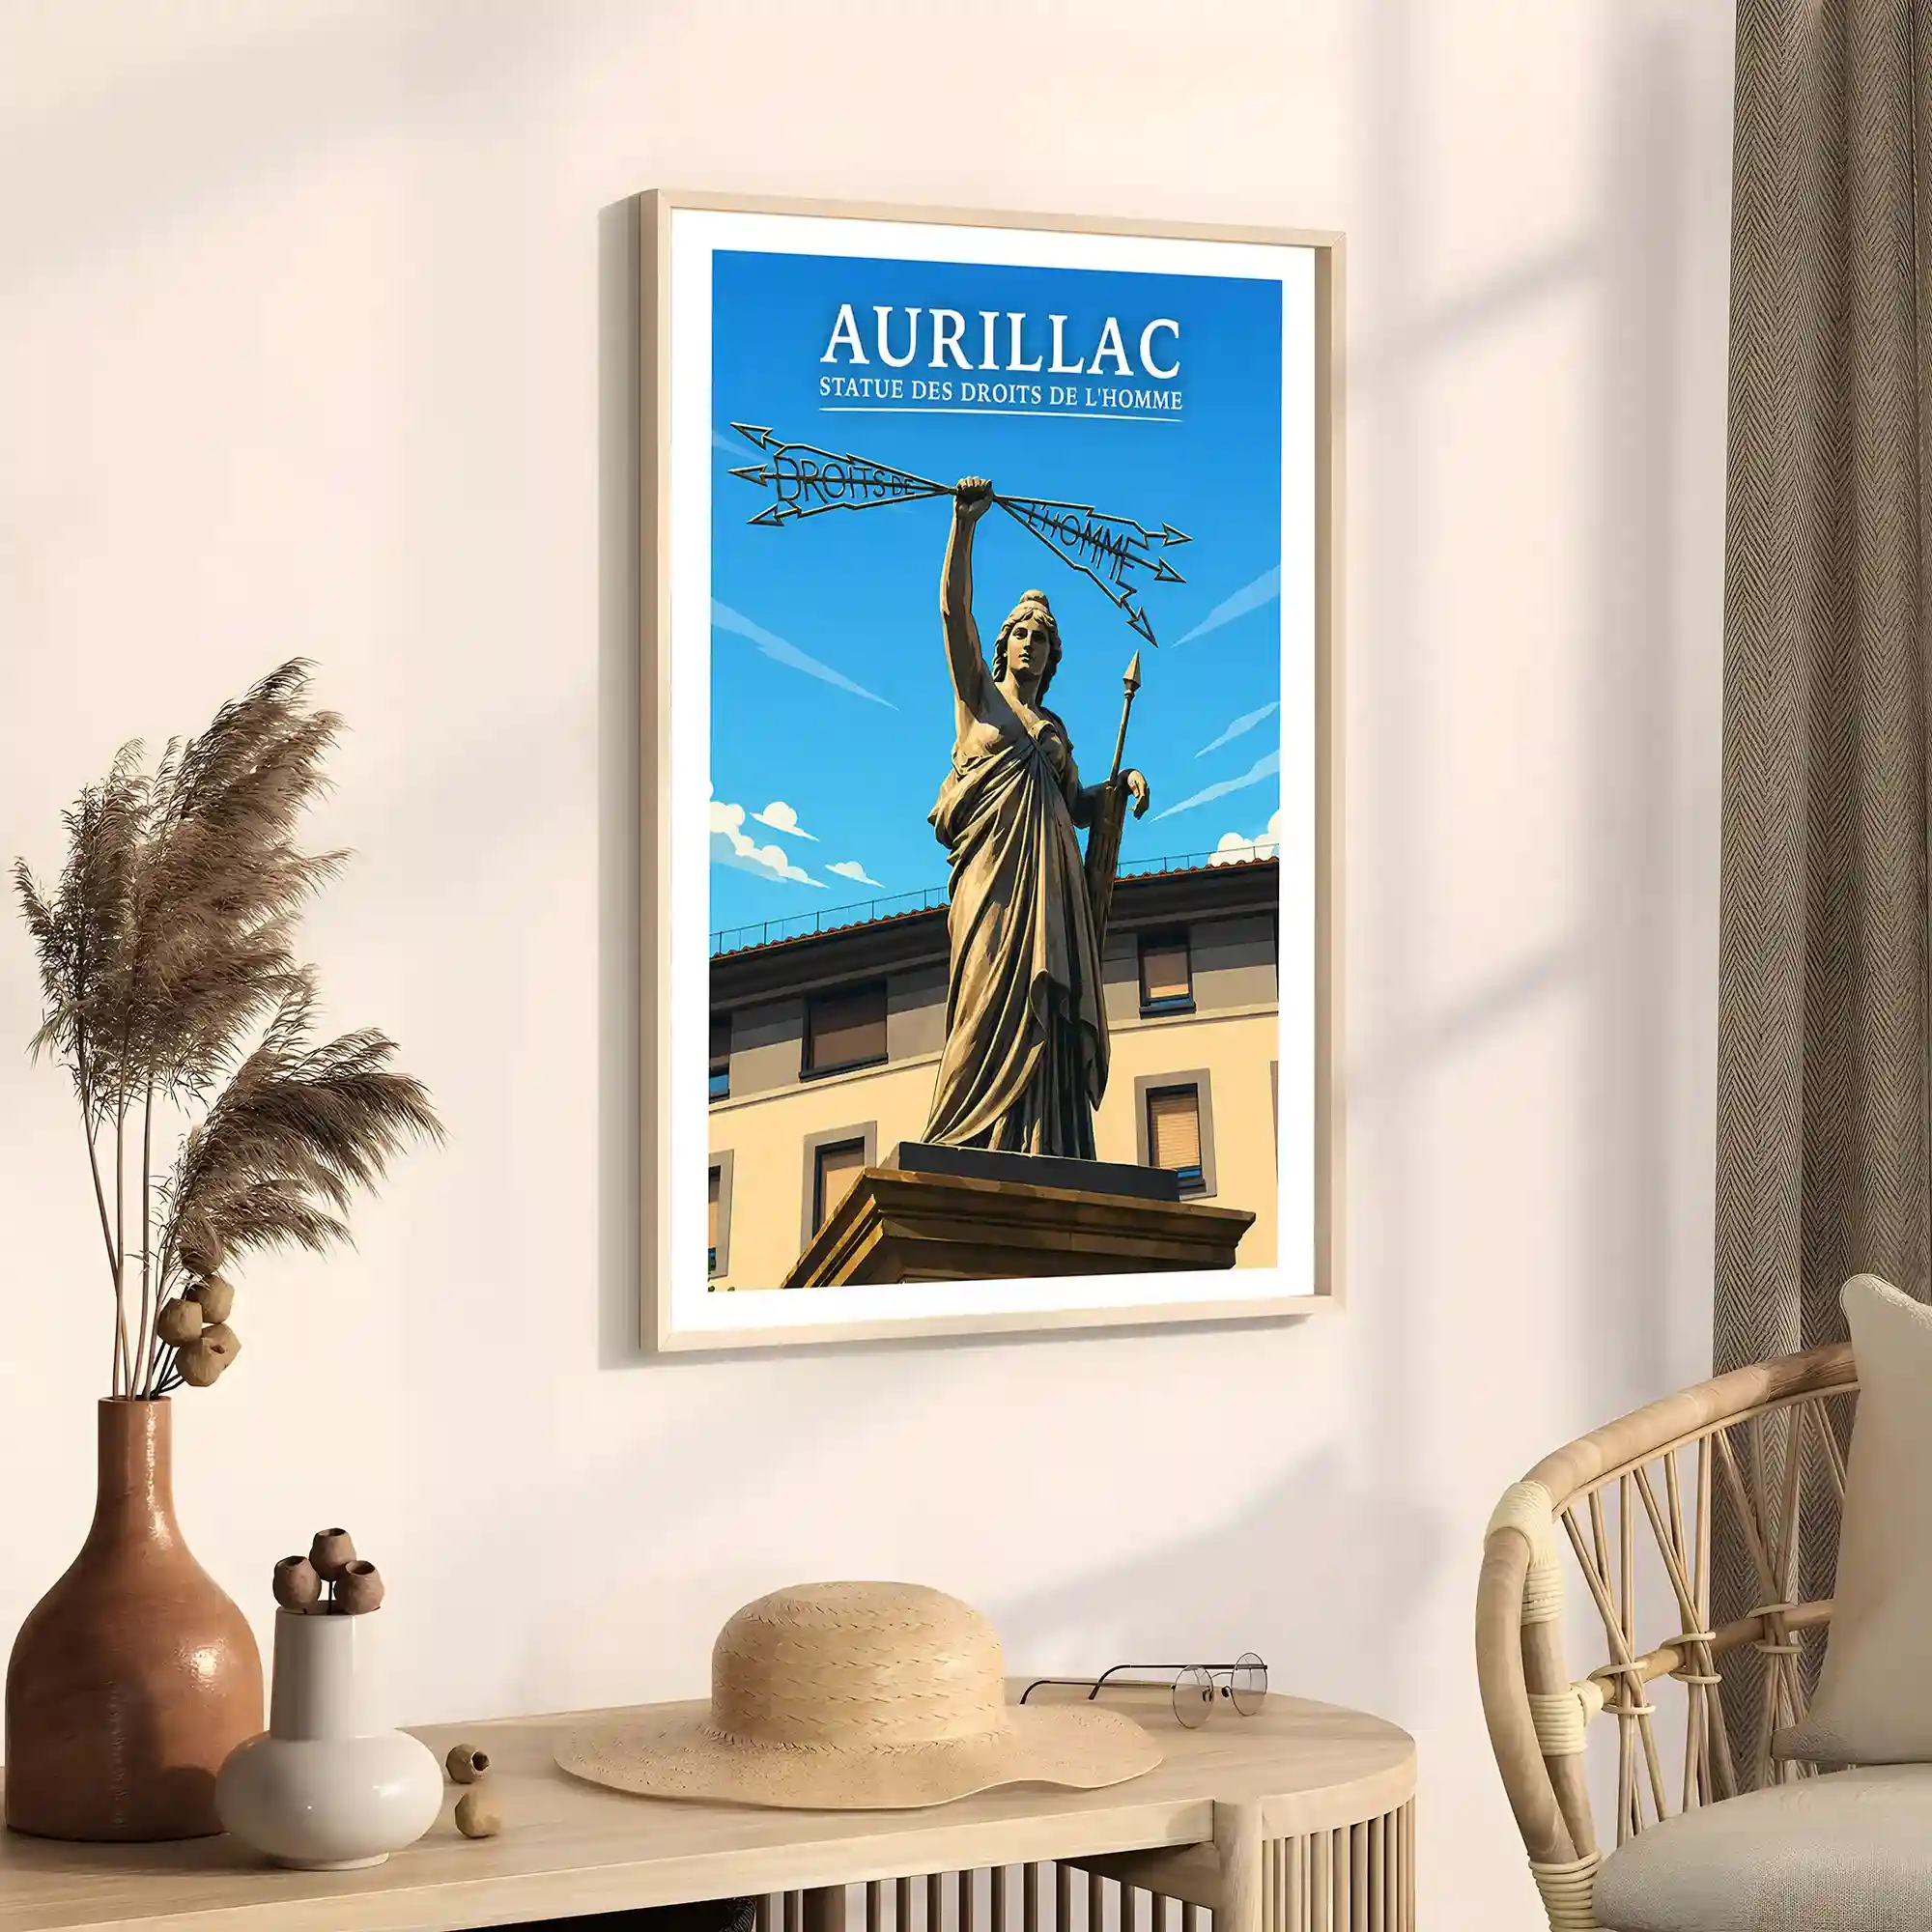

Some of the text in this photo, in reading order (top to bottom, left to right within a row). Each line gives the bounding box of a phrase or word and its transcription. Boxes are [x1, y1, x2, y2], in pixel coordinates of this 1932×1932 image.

[820, 303, 1181, 380] AURILLAC
[819, 376, 1183, 411] STATUE DES DROITS DE L'HOMME
[774, 455, 916, 504] DROITS DE
